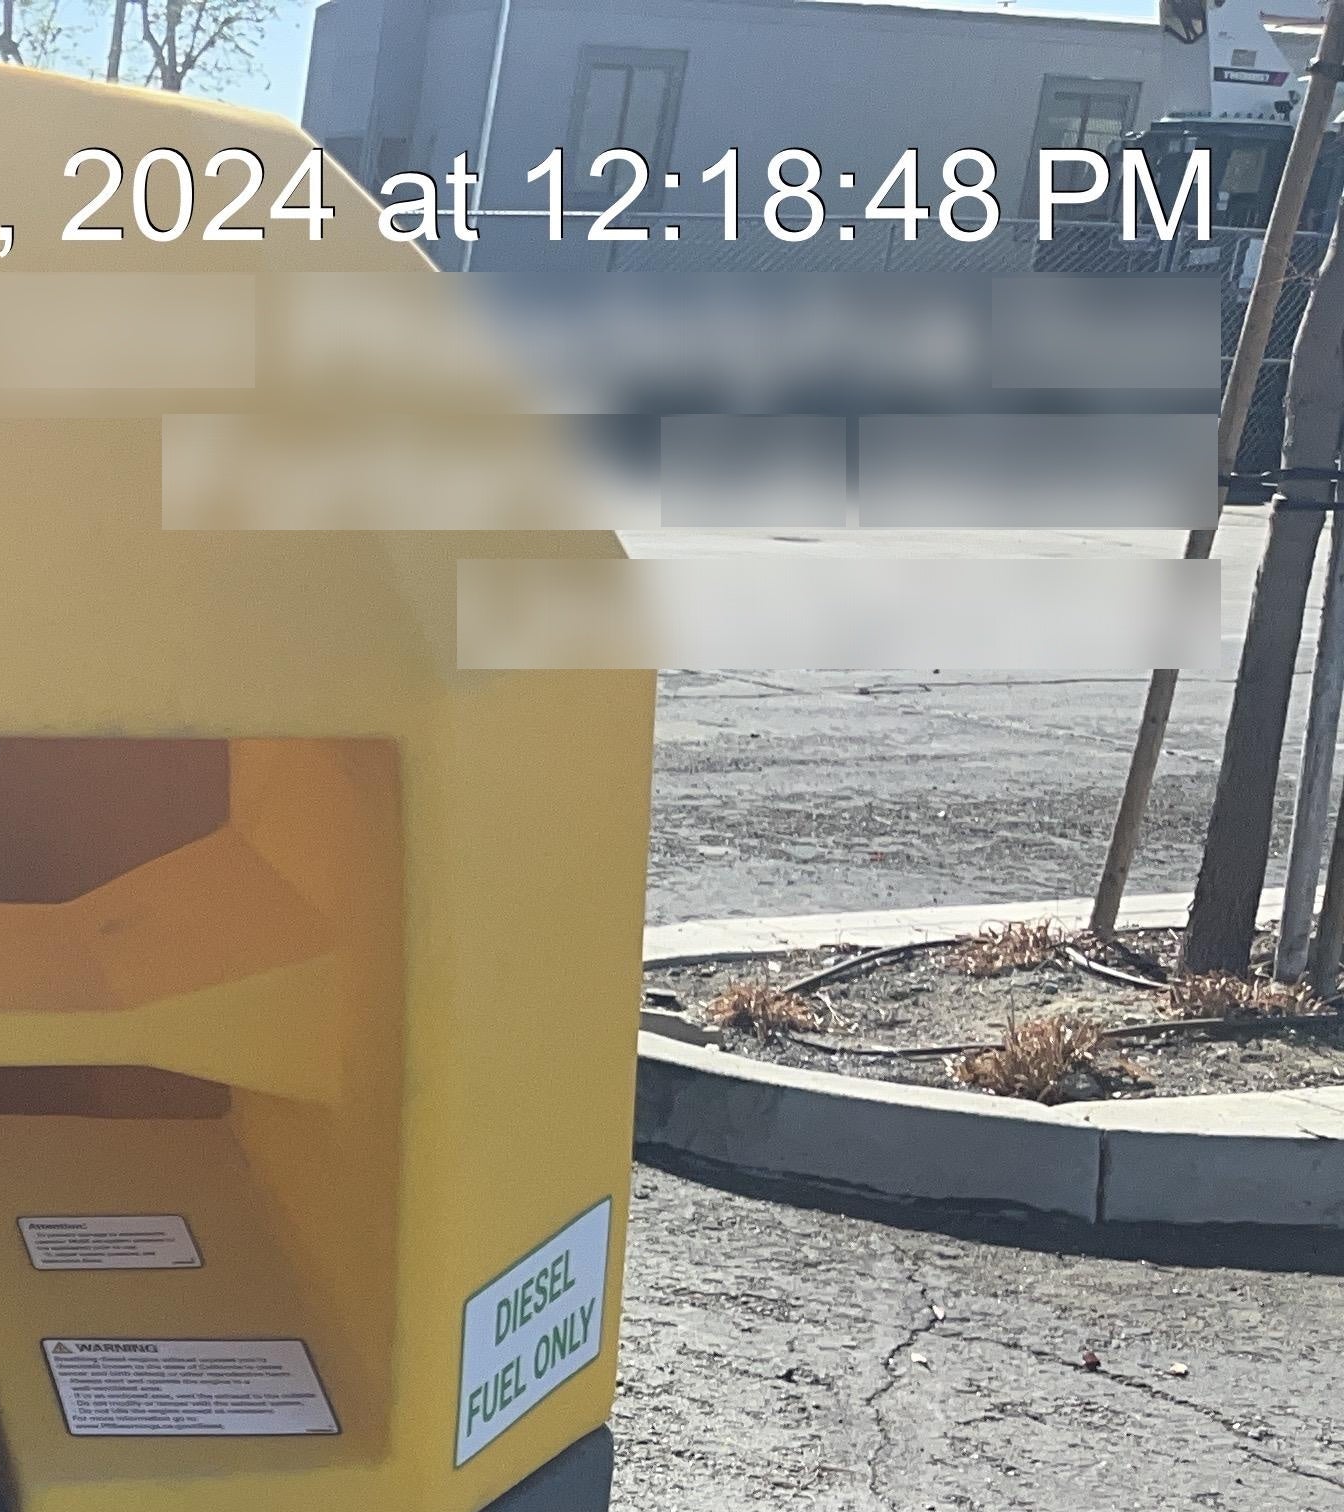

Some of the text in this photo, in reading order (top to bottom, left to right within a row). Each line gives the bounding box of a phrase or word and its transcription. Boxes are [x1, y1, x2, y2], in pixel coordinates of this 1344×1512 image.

[494, 1249, 576, 1347] DIESEL
[74, 1343, 159, 1353] WARNING
[466, 1297, 597, 1438] FUEL ONLY
